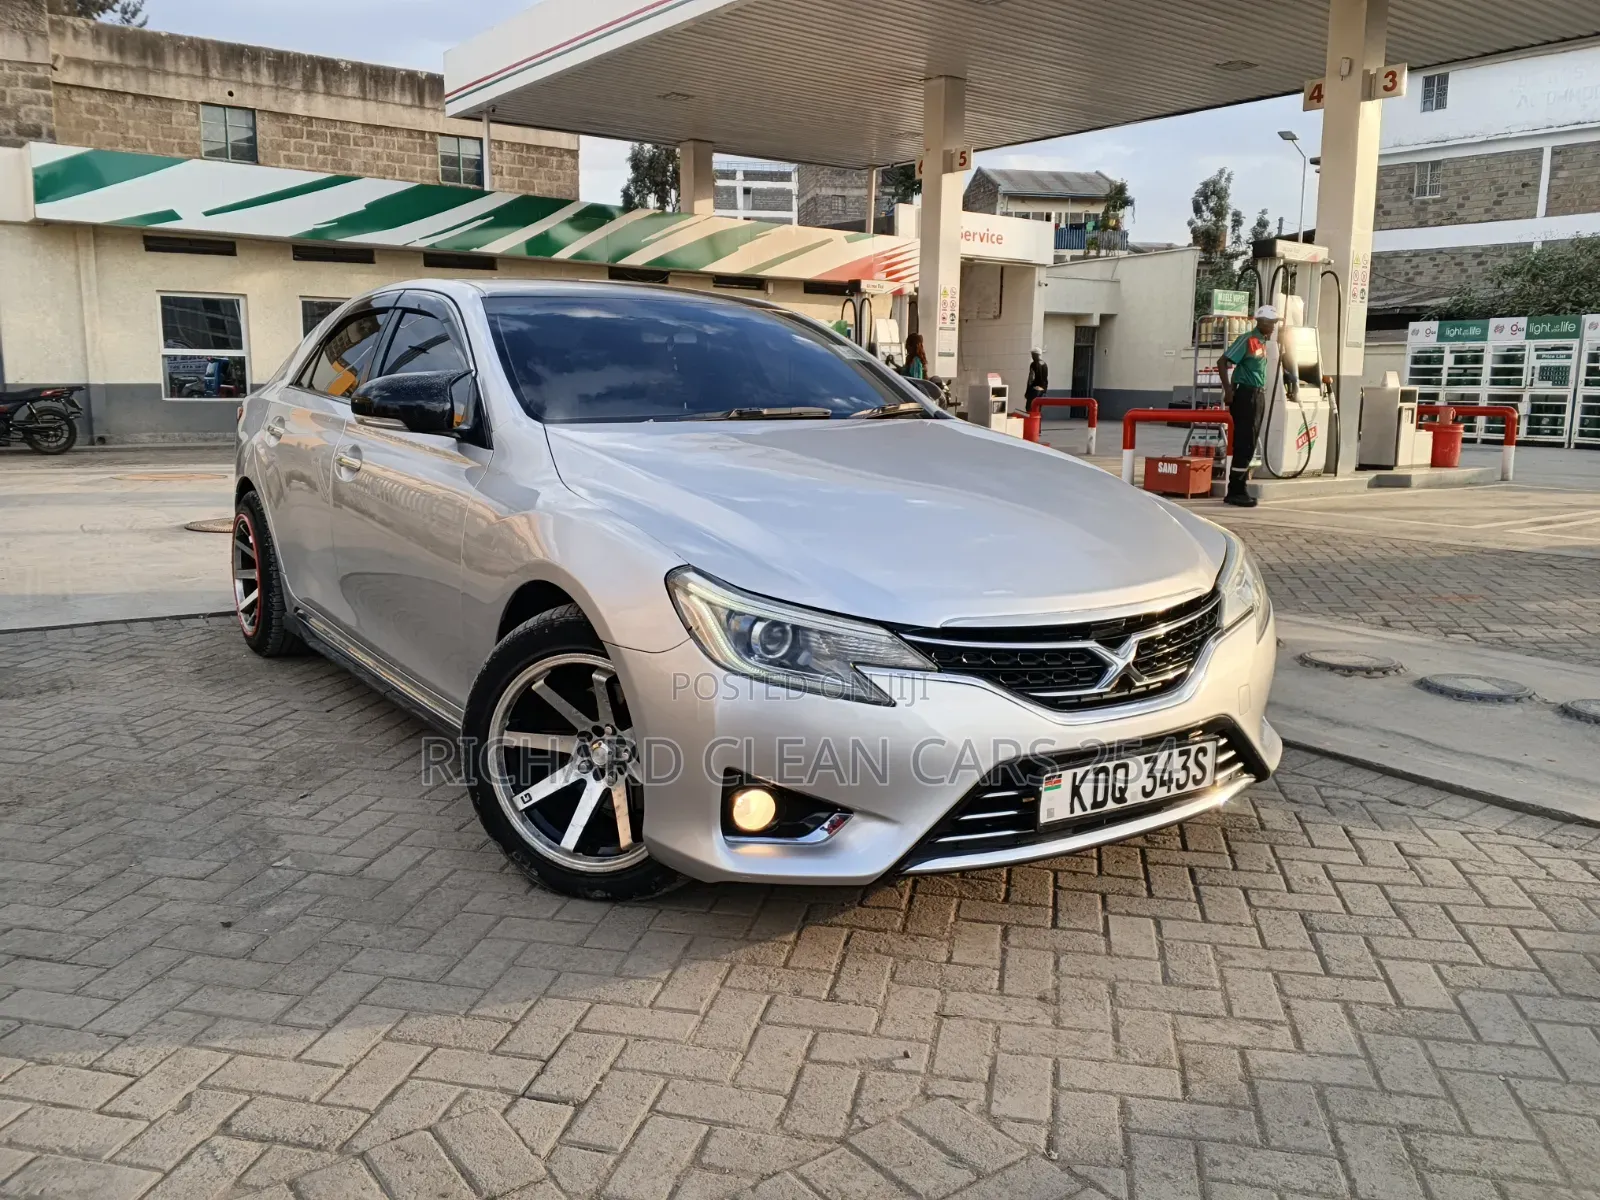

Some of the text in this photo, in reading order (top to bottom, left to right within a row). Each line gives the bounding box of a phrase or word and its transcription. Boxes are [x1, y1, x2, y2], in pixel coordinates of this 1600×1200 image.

[1383, 70, 1398, 92] 3
[1308, 83, 1324, 104] 4
[958, 150, 968, 167] 5
[1445, 326, 1463, 337] light
[1469, 325, 1482, 336] life
[1529, 322, 1551, 335] light
[1560, 320, 1577, 333] life
[1158, 461, 1178, 474] SAND
[1069, 746, 1208, 815] KDQ 343S
